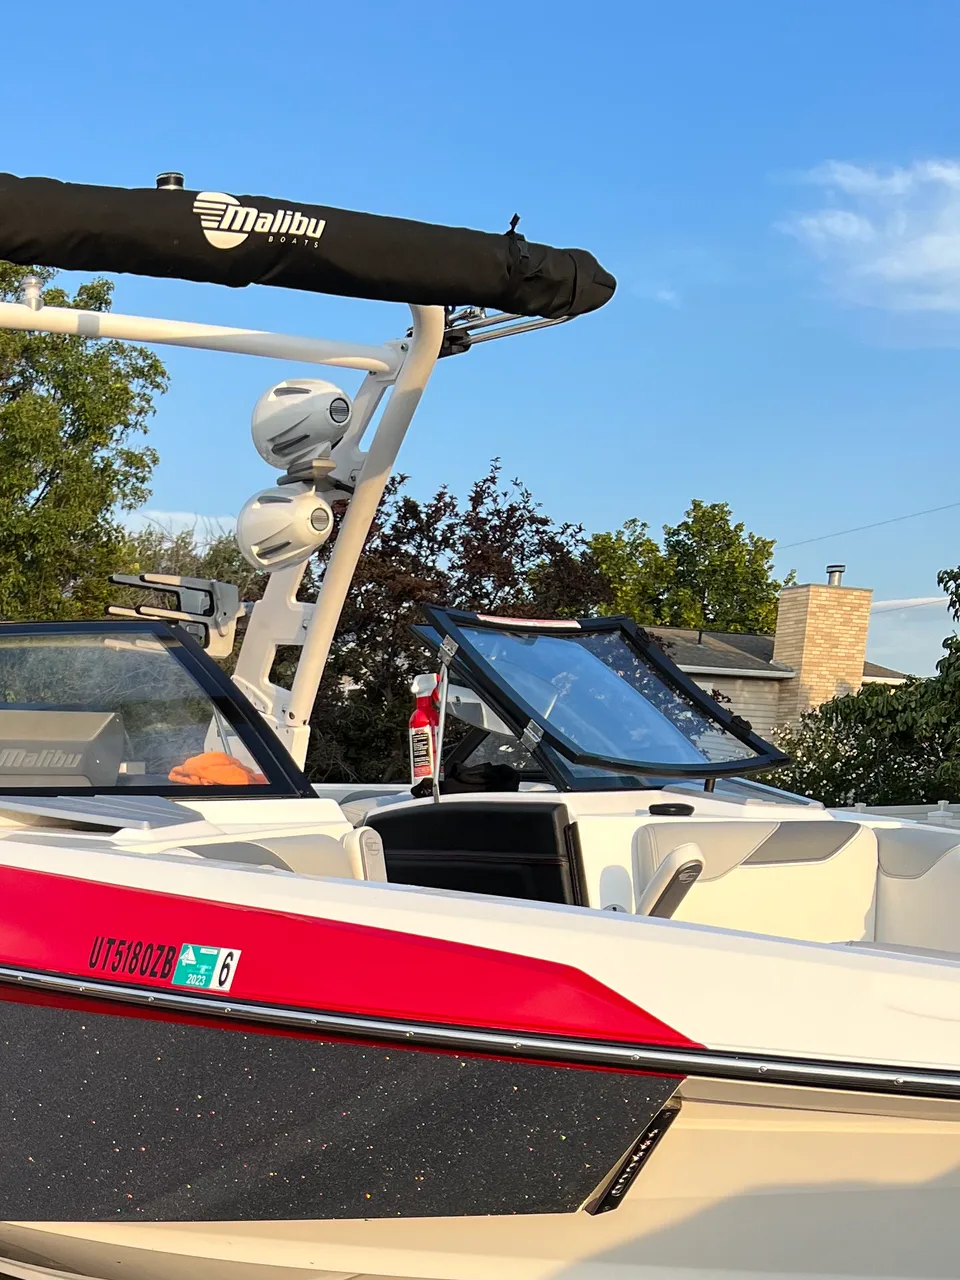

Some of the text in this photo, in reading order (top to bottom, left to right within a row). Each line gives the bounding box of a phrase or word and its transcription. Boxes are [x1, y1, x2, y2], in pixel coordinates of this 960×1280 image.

[219, 204, 327, 239] Malibu
[268, 235, 320, 249] BOATS
[89, 936, 177, 979] UT5180ZB
[218, 951, 234, 987] 6
[185, 973, 206, 986] 2023
